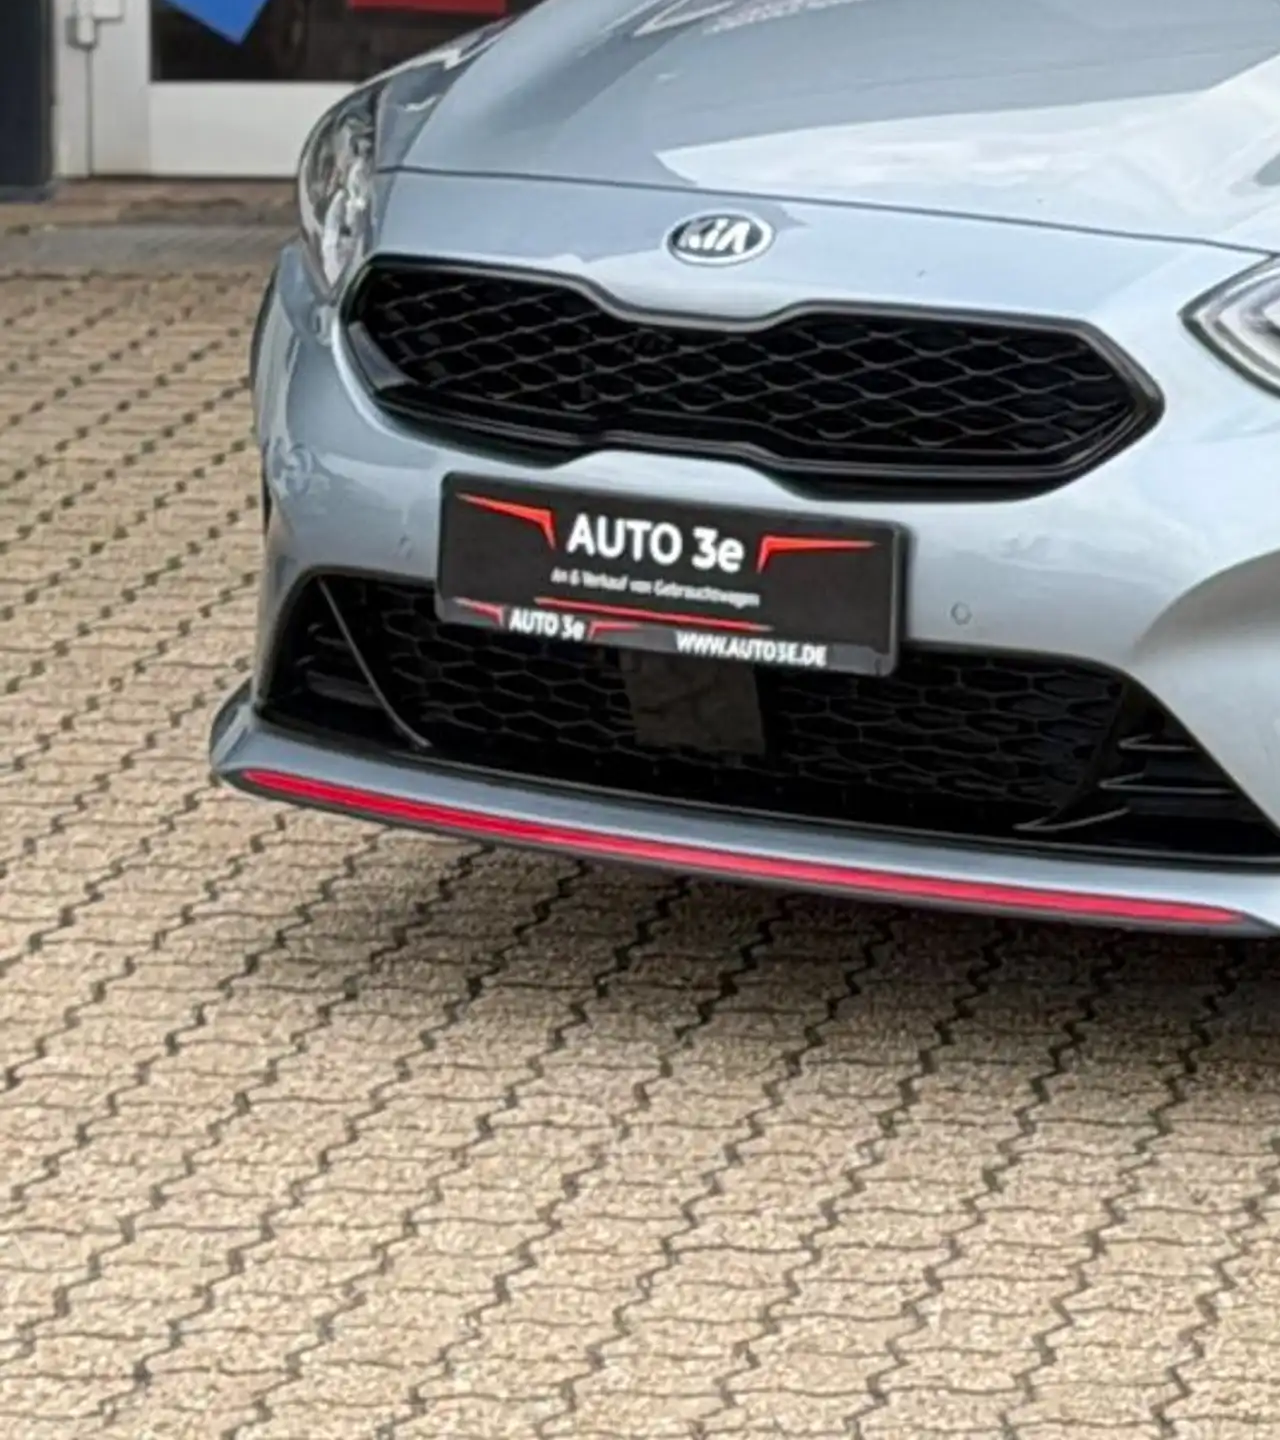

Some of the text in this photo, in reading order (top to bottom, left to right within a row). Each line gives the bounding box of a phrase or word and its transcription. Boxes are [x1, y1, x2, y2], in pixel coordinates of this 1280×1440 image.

[566, 513, 745, 573] AUTO 3e
[509, 607, 559, 637] AUTO
[561, 613, 585, 641] 3e
